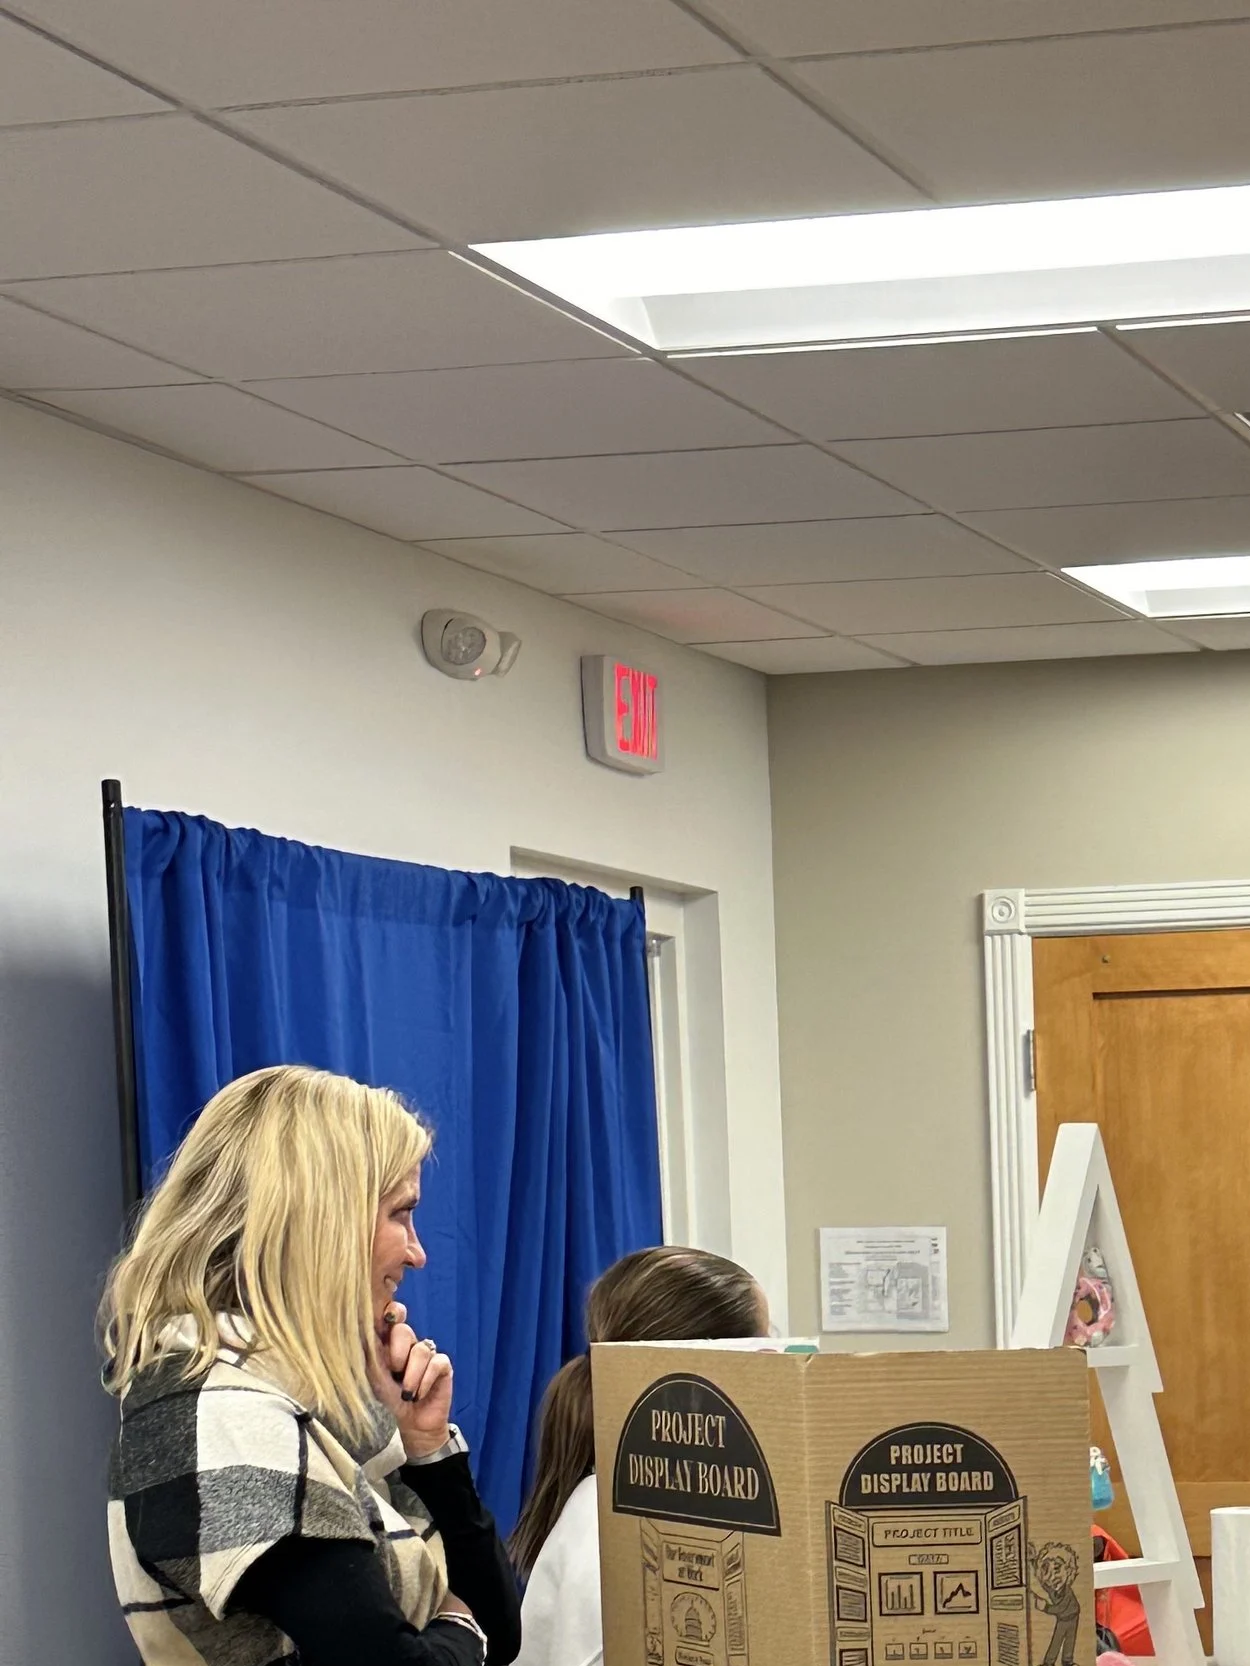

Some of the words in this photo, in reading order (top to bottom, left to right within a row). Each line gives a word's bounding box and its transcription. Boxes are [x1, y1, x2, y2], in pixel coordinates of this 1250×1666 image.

[651, 1409, 726, 1448] PROJECT
[890, 1443, 964, 1465] PROJECT
[629, 1453, 694, 1493] DISPLAY
[698, 1461, 760, 1500] BOARD
[860, 1472, 931, 1494] DISPLAY
[936, 1471, 994, 1492] BOARD
[884, 1527, 939, 1539] PROJECT
[943, 1526, 974, 1538] TITLE
